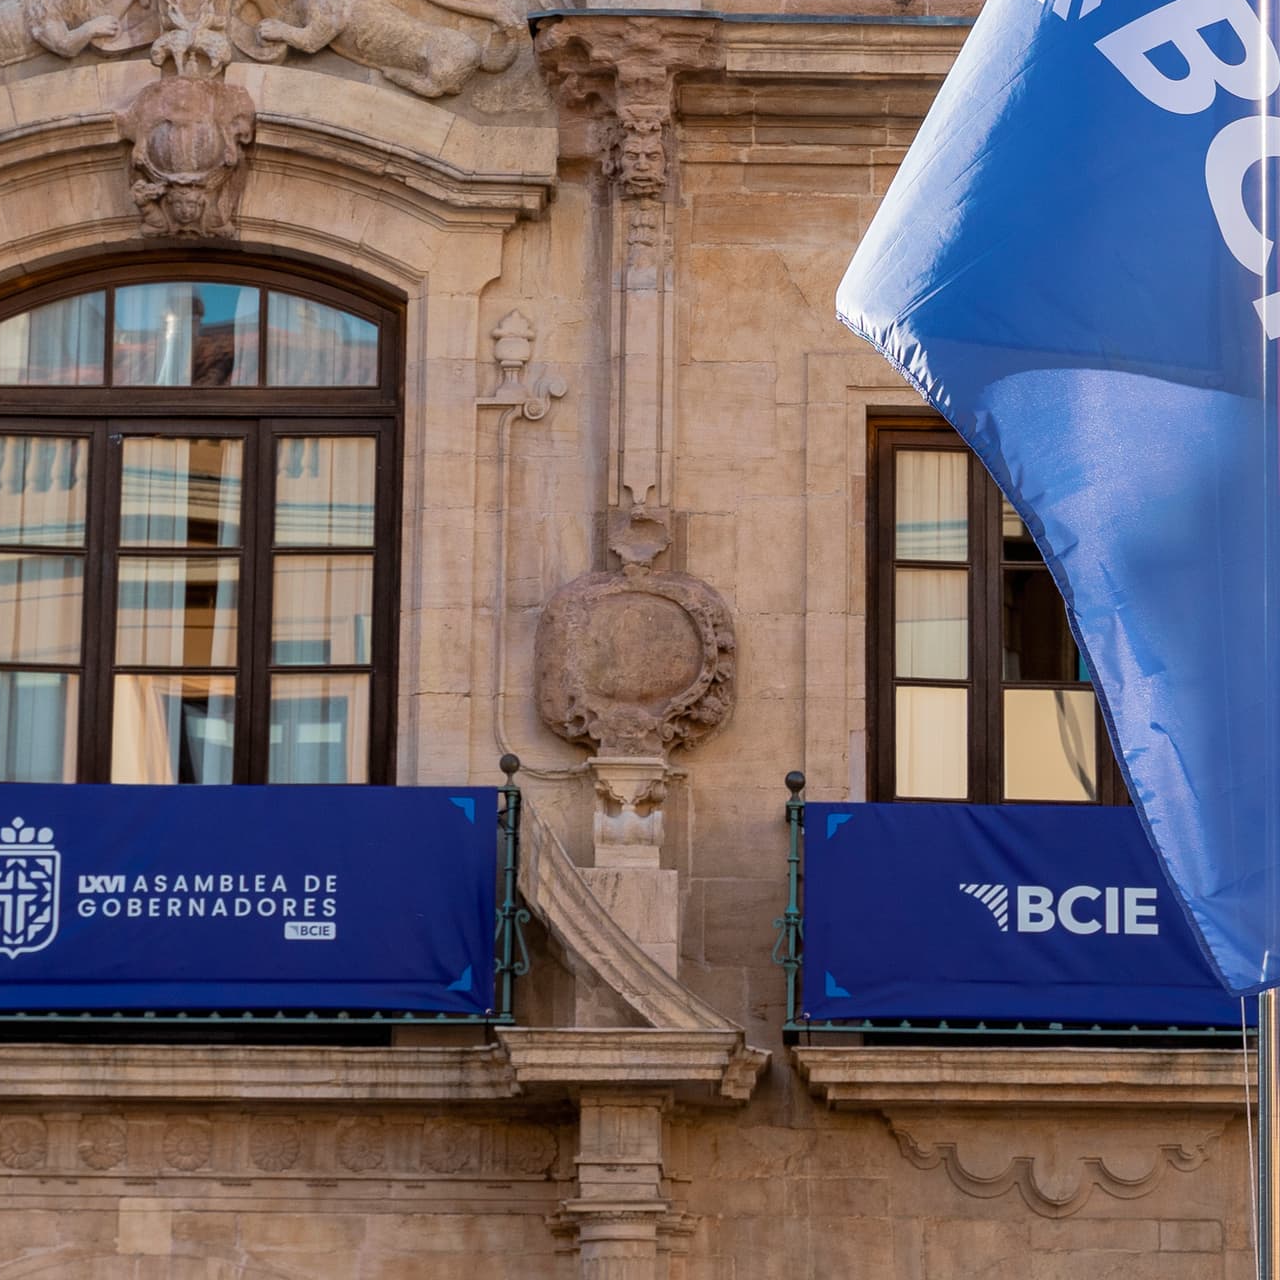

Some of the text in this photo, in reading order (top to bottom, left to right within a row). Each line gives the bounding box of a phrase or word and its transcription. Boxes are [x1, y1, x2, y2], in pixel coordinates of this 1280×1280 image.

[78, 874, 338, 894] LXVI ASAMBLEA DE
[77, 897, 337, 918] GOBERNADORES
[1016, 884, 1160, 936] BCIE
[300, 925, 331, 937] BCIE
